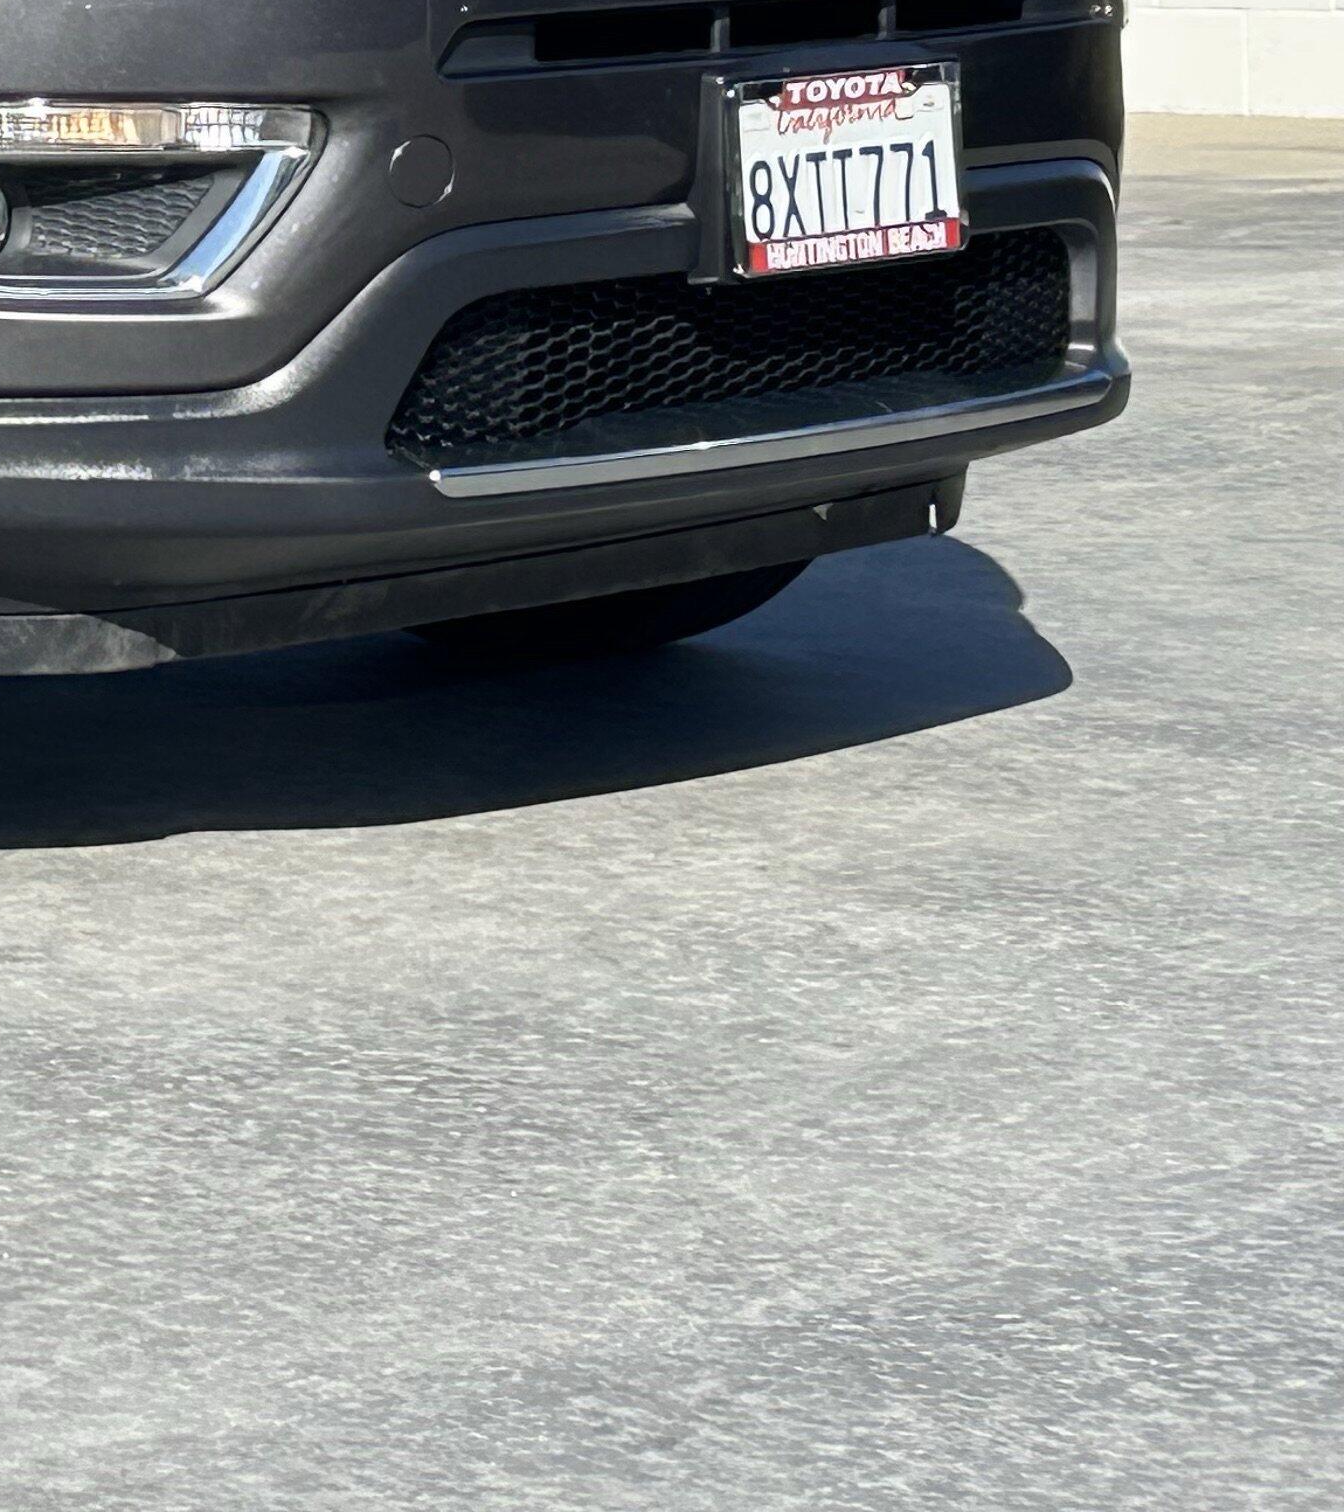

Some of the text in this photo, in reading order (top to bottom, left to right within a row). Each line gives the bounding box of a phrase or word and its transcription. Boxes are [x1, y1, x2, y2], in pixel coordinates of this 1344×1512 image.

[786, 72, 903, 104] TOYOTA
[777, 97, 915, 144] California
[749, 139, 948, 242] 8XTT771
